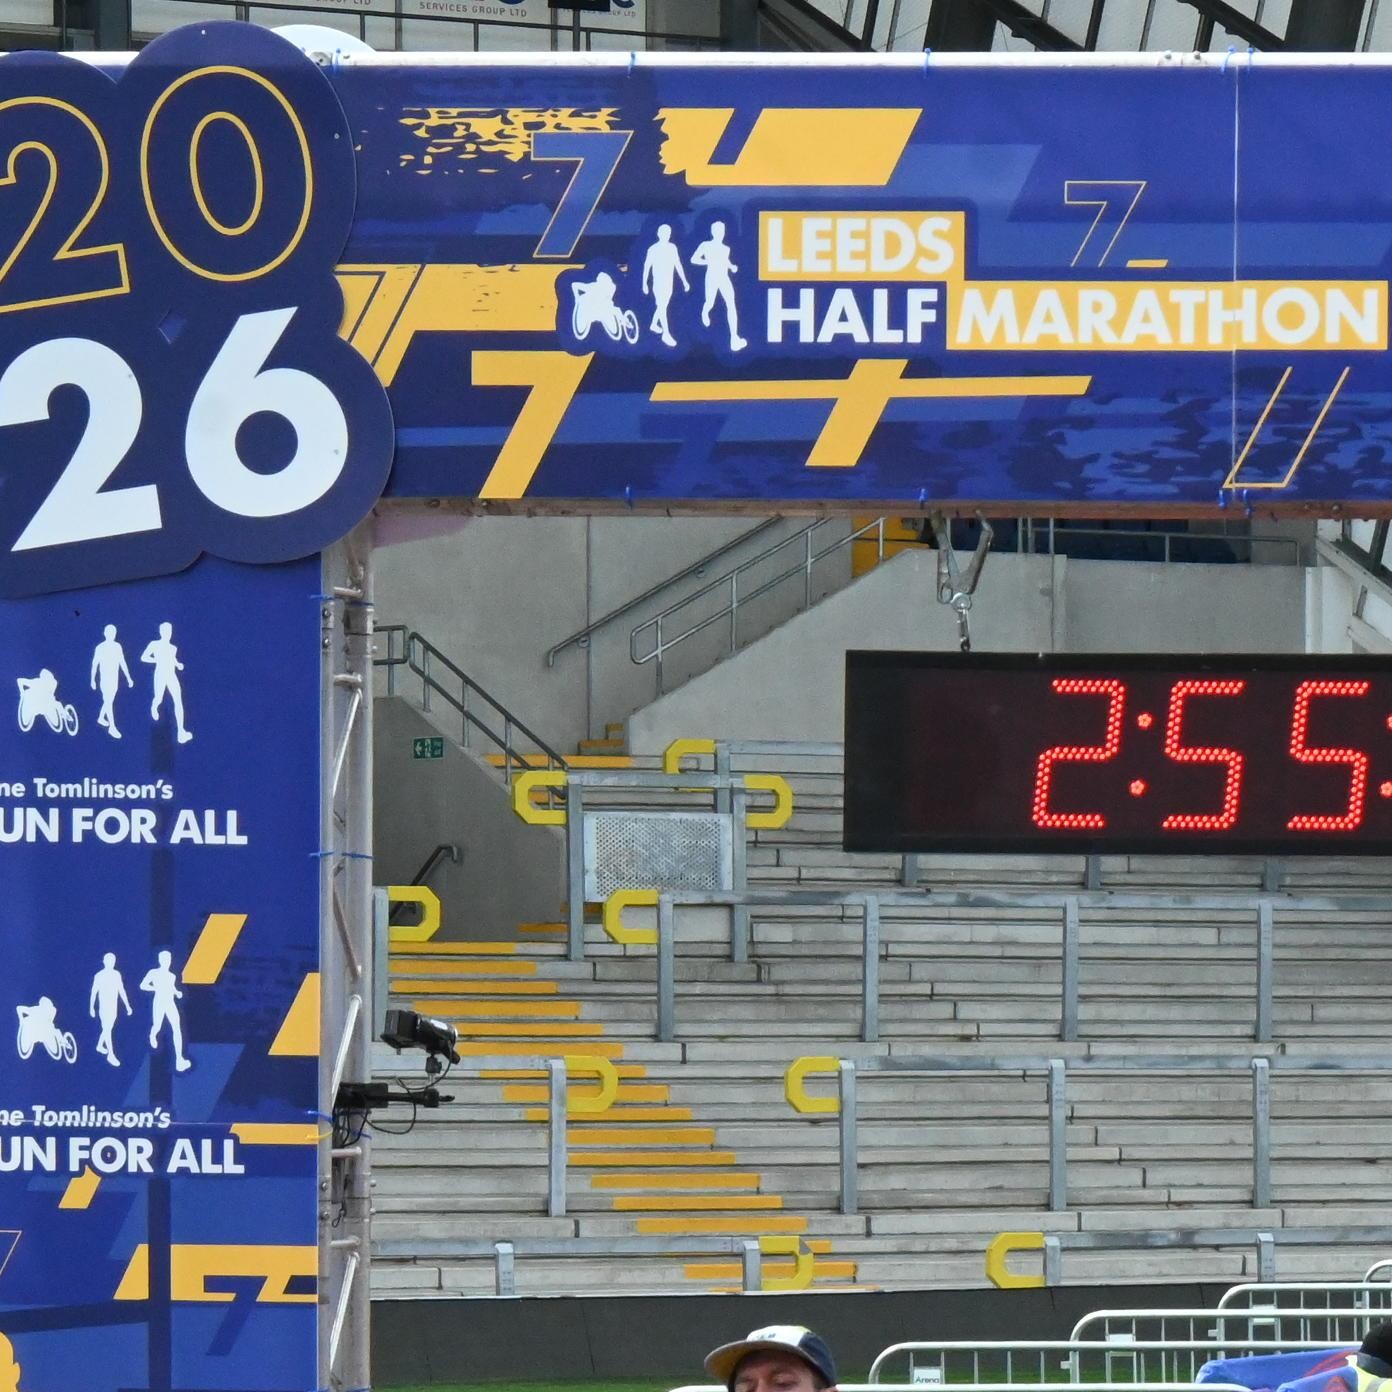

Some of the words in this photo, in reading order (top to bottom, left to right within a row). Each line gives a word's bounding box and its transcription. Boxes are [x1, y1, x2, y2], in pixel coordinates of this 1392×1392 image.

[420, 2, 468, 13] SERVICES
[471, 5, 506, 16] GROUP
[510, 8, 528, 18] LTD
[767, 216, 955, 273] LEEDS
[767, 287, 938, 344] HALF
[957, 287, 1380, 345] MARATHON
[0, 307, 349, 552] 26
[33, 777, 174, 801] Tomlinson's
[72, 807, 160, 845] FOR
[169, 809, 248, 846] ALL
[32, 1105, 171, 1129] Tomlinson's
[69, 1137, 154, 1174] FOR
[166, 1137, 245, 1175] ALL
